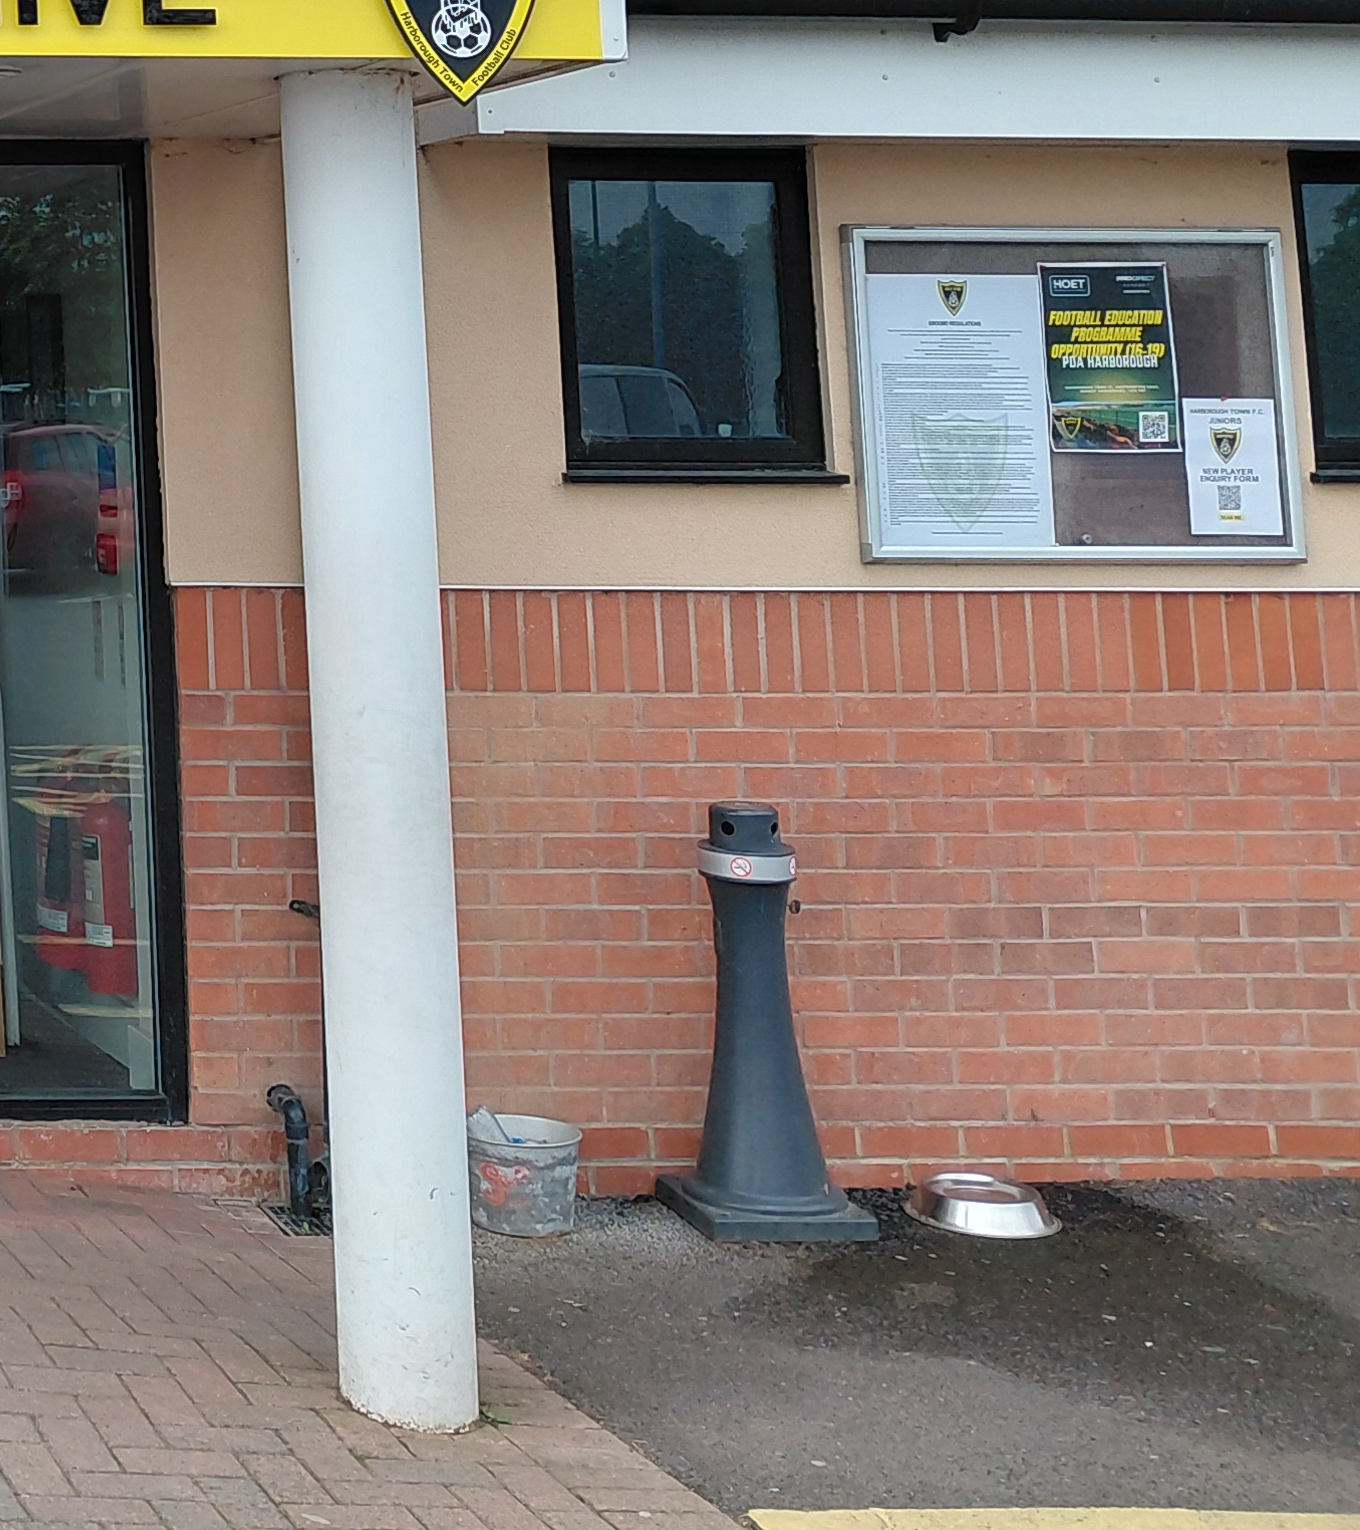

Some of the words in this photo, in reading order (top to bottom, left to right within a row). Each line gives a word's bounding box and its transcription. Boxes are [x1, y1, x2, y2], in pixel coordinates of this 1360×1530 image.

[399, 10, 441, 70] Harborough
[435, 66, 464, 94] Town
[470, 49, 505, 87] Football
[499, 27, 518, 53] Club
[1053, 279, 1086, 289] HOET
[1048, 310, 1102, 326] FOOTBALL
[1104, 310, 1164, 326] EDUCATION
[1070, 327, 1143, 342] PROGRAMME
[1050, 343, 1124, 359] OPPORTUNITY
[1125, 343, 1166, 358] (16-19)
[1062, 356, 1085, 369] PDA
[1087, 355, 1159, 369] HARBOROUGH
[1209, 417, 1242, 425] JUNIORS
[1199, 475, 1232, 483] ENQUIRY
[1233, 475, 1260, 483] FORM
[1220, 468, 1254, 476] PLAYER
